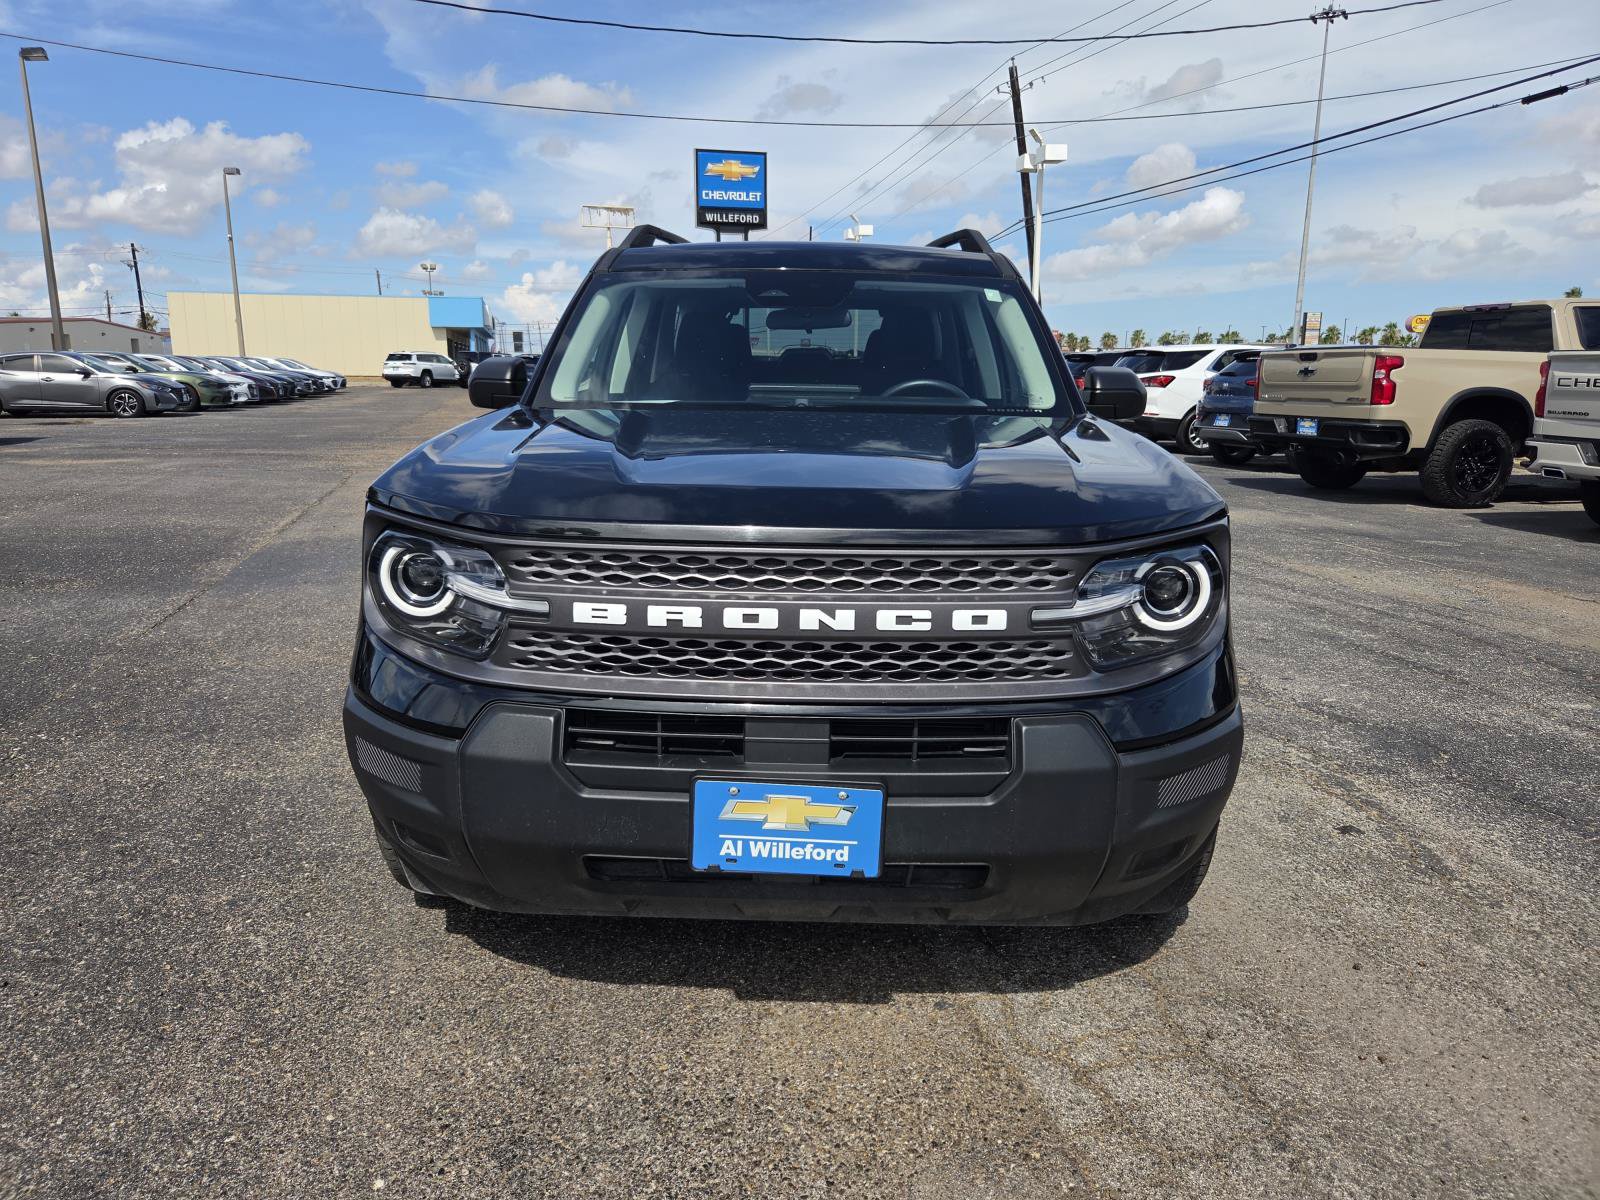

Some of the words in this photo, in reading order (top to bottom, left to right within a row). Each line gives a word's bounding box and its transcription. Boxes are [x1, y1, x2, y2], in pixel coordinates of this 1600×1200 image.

[702, 190, 762, 202] CHEVROLET
[705, 212, 760, 224] WILLEFORD
[572, 601, 1008, 631] BRONCO
[719, 839, 743, 857] Al
[749, 840, 849, 862] Willeford
